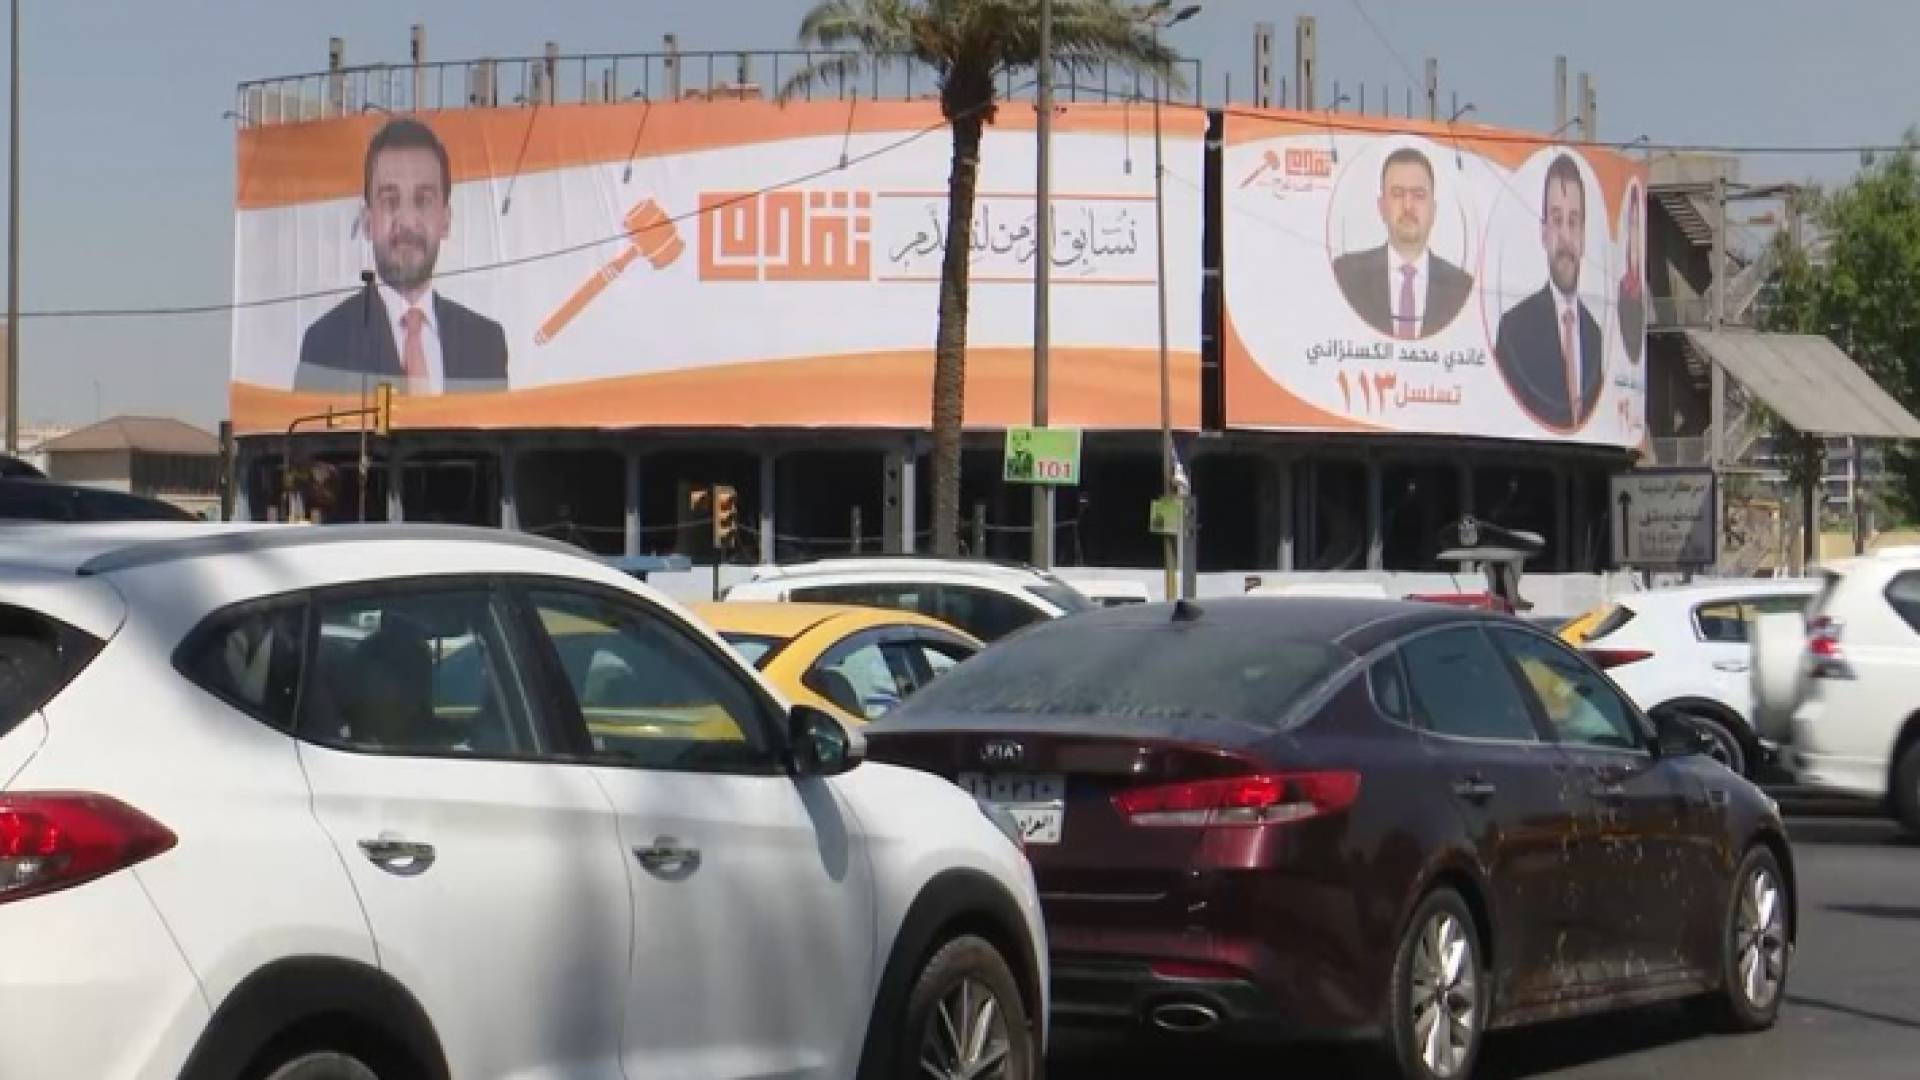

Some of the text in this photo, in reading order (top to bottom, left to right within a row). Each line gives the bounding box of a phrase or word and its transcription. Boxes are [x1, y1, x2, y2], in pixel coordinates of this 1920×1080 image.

[699, 191, 871, 282] تقدم
[1399, 347, 1440, 363] محمد
[1440, 348, 1487, 373] غاندي
[1336, 368, 1462, 417] تسلسل ١١٣
[1037, 460, 1073, 478] 101
